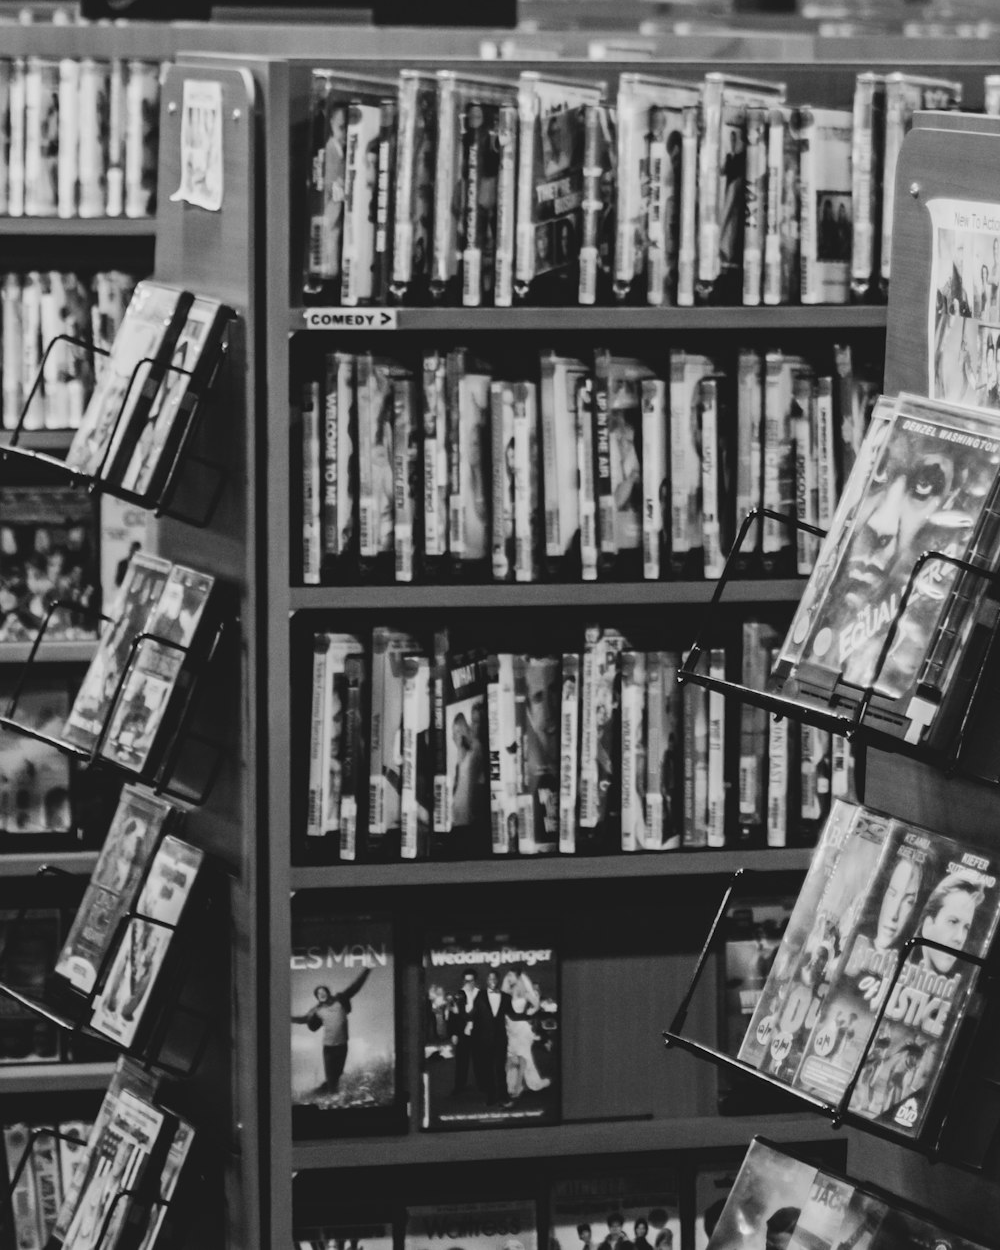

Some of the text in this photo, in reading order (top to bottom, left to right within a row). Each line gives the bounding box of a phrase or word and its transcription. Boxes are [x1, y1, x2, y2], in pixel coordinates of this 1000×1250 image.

[954, 213, 969, 228] New
[972, 214, 981, 229] To
[311, 314, 375, 326] COMEDY
[325, 392, 337, 460] WELCOME
[596, 392, 609, 478] UP IN THE AIR
[902, 420, 1000, 453] DENZEL WASHINGTON
[325, 463, 337, 482] TO
[623, 719, 631, 753] WILDE
[962, 852, 990, 871] KIEFER
[290, 942, 387, 970] ES MAN
[896, 1101, 918, 1122] DVD
